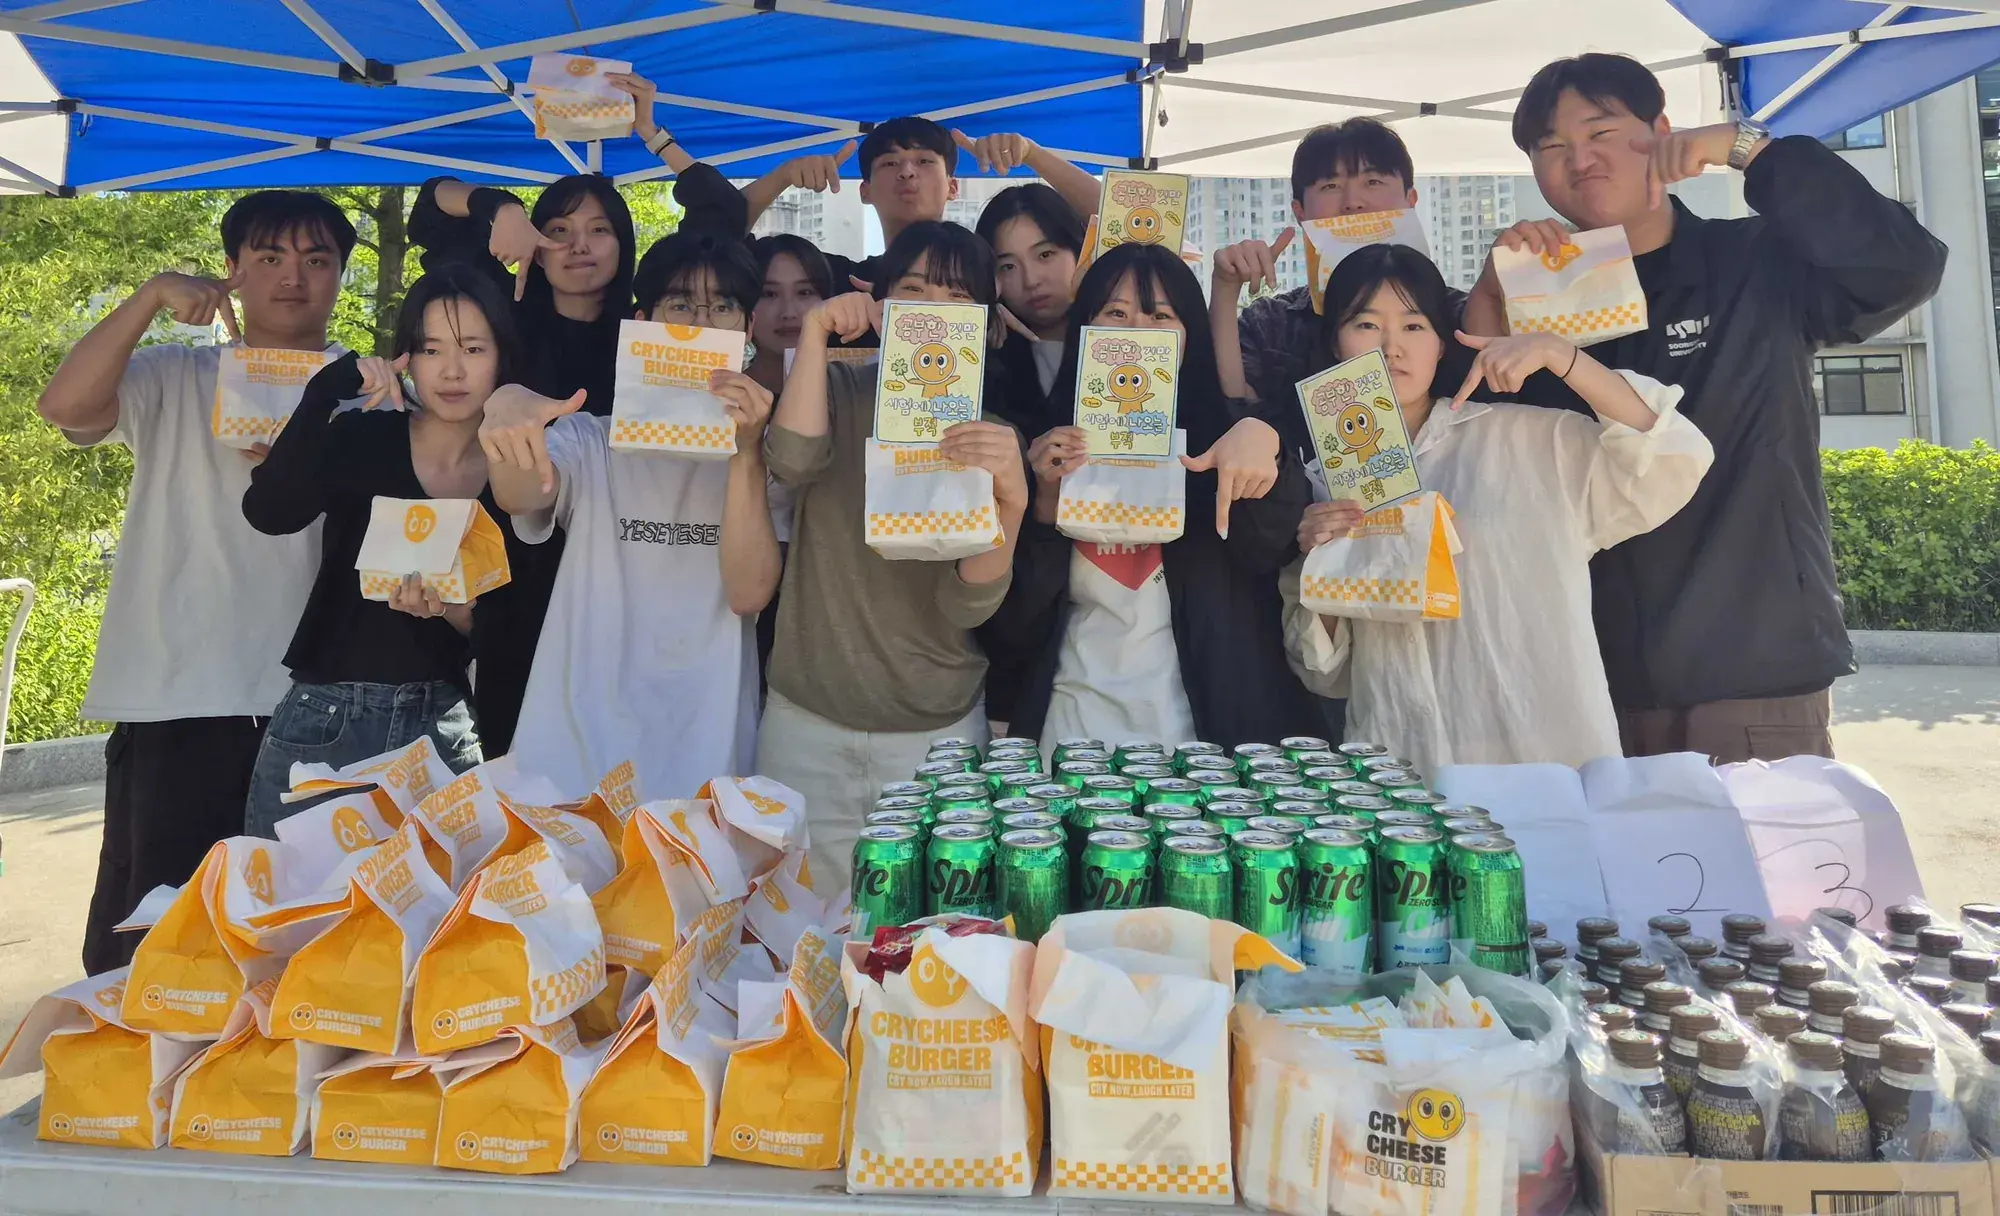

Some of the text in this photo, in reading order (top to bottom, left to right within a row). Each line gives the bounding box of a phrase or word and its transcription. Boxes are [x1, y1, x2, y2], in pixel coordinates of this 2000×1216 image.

[1116, 184, 1183, 206] 공부한 것만
[901, 318, 979, 341] 공부한 것만
[234, 348, 325, 366] CRYCHEESE
[629, 340, 730, 369] CRYCHEESE
[1098, 342, 1172, 363] 공부한 것만
[246, 361, 310, 378] BURGER
[643, 359, 713, 384] BURGER
[1316, 382, 1352, 413] 공부한
[1354, 369, 1382, 396] 것만
[884, 396, 969, 418] 시험에 나오는
[913, 416, 939, 437] 부적
[1082, 413, 1164, 433] 시험에 나오는
[1110, 431, 1134, 450] 부적
[1332, 451, 1406, 488] 시험에 나오는
[1360, 478, 1386, 503] 부적
[620, 518, 721, 546] YESEYESE
[1657, 852, 1731, 914] 2
[1814, 862, 1873, 923] 3
[1408, 898, 1431, 907] ZERO
[165, 988, 228, 1005] CRYCHEESE
[166, 1002, 206, 1017] BURGER
[457, 995, 521, 1019] CRYCHEESE
[314, 1007, 383, 1028] CRYCHEESE
[459, 1013, 504, 1032] BURGER
[870, 1010, 1010, 1044] CRYCHEESE
[315, 1020, 362, 1036] BURGER
[888, 1043, 992, 1072] BURGER
[888, 1073, 905, 1088] CRY
[964, 1075, 990, 1088] LATER
[1090, 1082, 1108, 1096] CRY
[1165, 1083, 1193, 1098] LATER
[74, 1116, 139, 1129] CRYCHEESE
[213, 1118, 282, 1130] CRYCHEESE
[1368, 1110, 1412, 1137] CRY
[76, 1127, 120, 1140] BURGER
[213, 1129, 262, 1142] BURGER
[360, 1126, 426, 1140] CRYCHEESE
[482, 1135, 549, 1150] CRYCHEESE
[623, 1127, 689, 1142] CRYCHEESE
[759, 1128, 824, 1145] CRYCHEESE
[360, 1138, 407, 1151] BURGER
[623, 1141, 669, 1155] BURGER
[758, 1143, 804, 1157] BURGER
[1366, 1134, 1447, 1166] CHEESE
[482, 1150, 528, 1163] BURGER
[1364, 1155, 1446, 1188] BURGER
